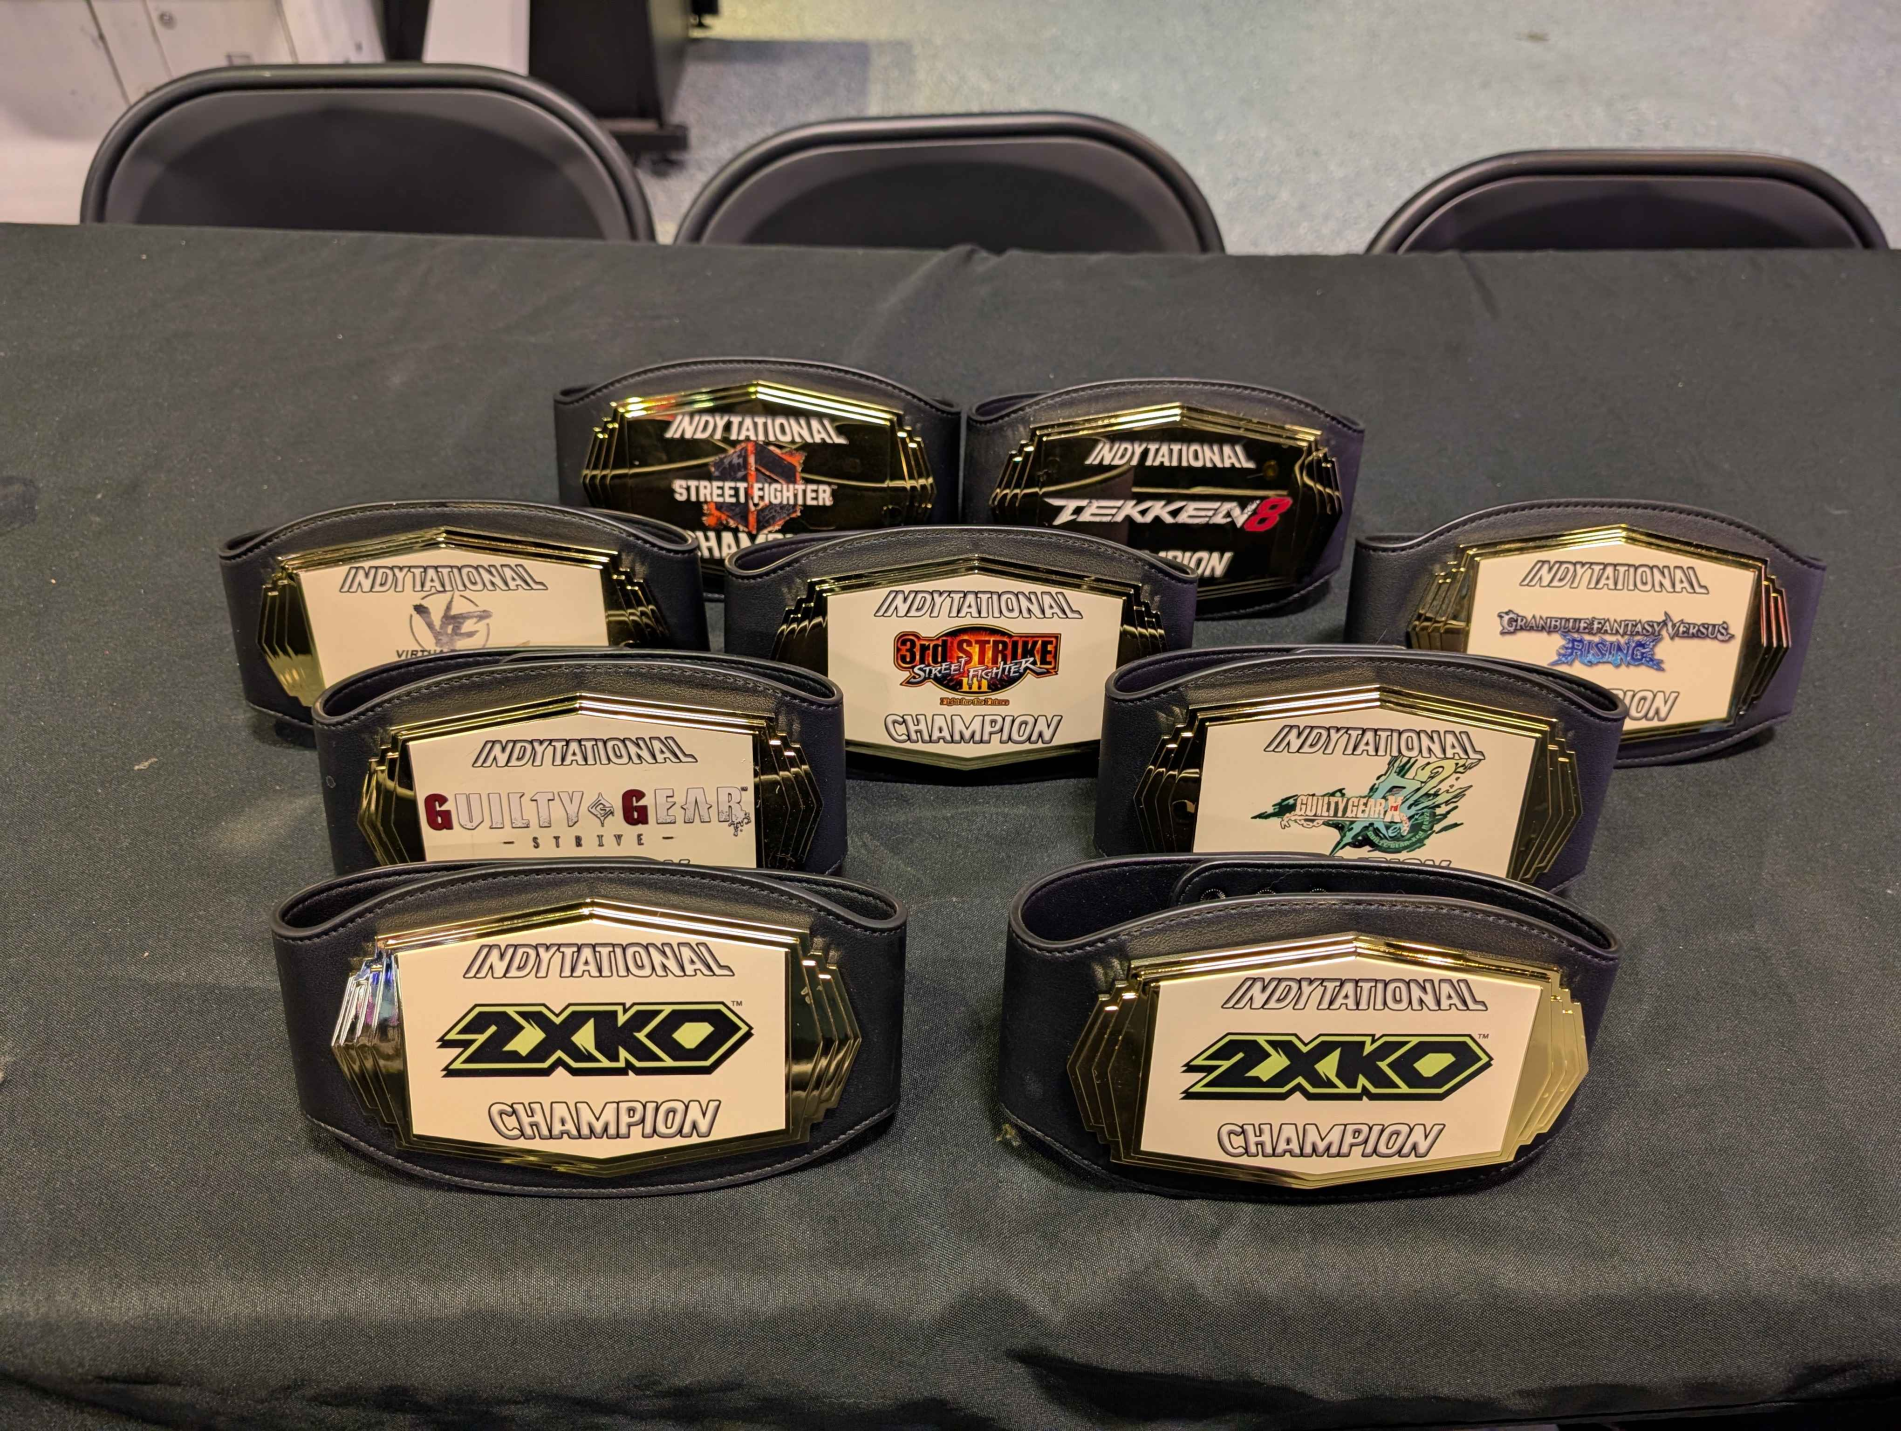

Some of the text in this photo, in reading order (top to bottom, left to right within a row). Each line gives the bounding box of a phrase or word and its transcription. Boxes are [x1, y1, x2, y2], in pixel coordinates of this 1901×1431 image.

[664, 414, 849, 445] INDYTATIONAL
[1085, 441, 1256, 469] INDYTATIONAL
[673, 480, 834, 507] STREET FIGHTER
[1043, 496, 1293, 532] TEKKEN 8
[339, 564, 548, 593] INDYTATIONAL
[1519, 560, 1710, 594] INDYTATIONAL
[874, 590, 1083, 619] INDYTATIONAL
[1498, 609, 1736, 643] GRANBLUE FANTASY VERSUS
[899, 637, 1055, 667] 3rd STRIKE
[1558, 633, 1661, 670] RISING
[909, 656, 1048, 686] STREET FIGHTER
[884, 713, 1063, 744] CHAMPION
[1264, 725, 1486, 760] INDYTATIONAL
[472, 736, 698, 768] INDYTATIONAL
[424, 786, 751, 833] GUILTY GEAR
[1295, 794, 1347, 819] GUILTY
[1346, 797, 1386, 819] GEAR
[532, 833, 645, 849] STRIVE
[463, 942, 735, 979] INDYTATIONAL
[1221, 977, 1488, 1011] INDYTATIONAL
[436, 1001, 754, 1078] 2XKO
[1179, 1032, 1494, 1101] 2XKO
[488, 1100, 721, 1140] CHAMPION
[1217, 1123, 1446, 1158] CHAMPION
